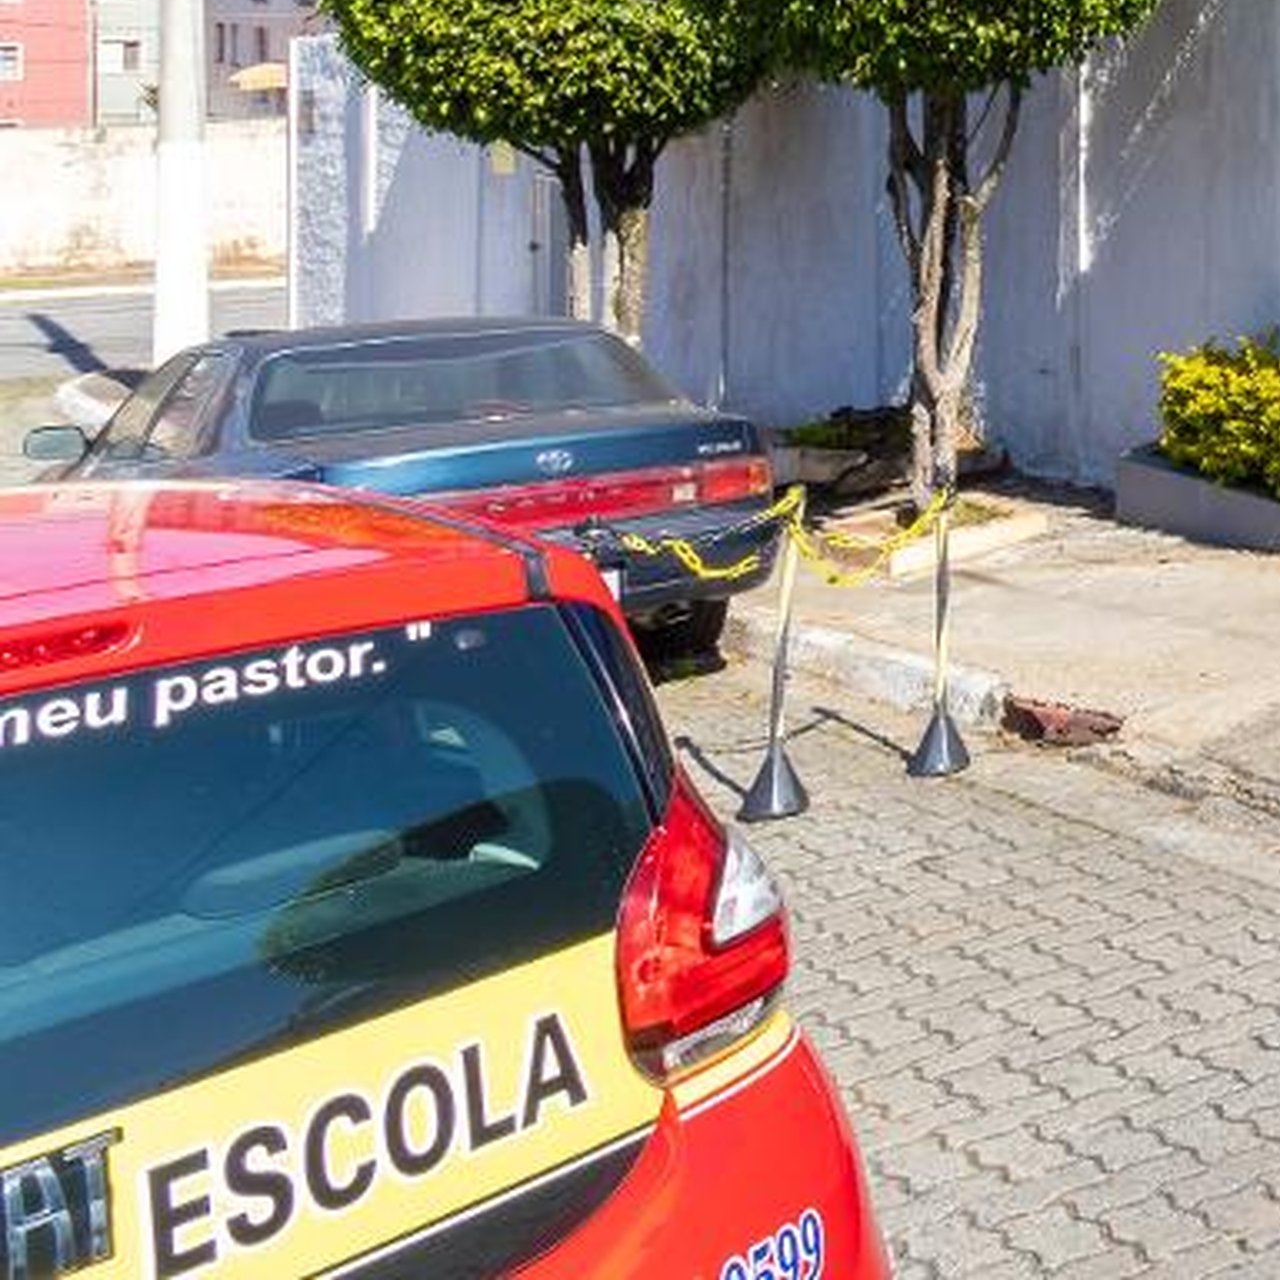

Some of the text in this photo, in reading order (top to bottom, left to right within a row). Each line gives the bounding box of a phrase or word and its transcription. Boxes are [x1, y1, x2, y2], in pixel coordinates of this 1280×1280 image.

[153, 641, 387, 728] pastor.
[146, 1013, 589, 1277] ESCOLA
[719, 1207, 824, 1280] 599
